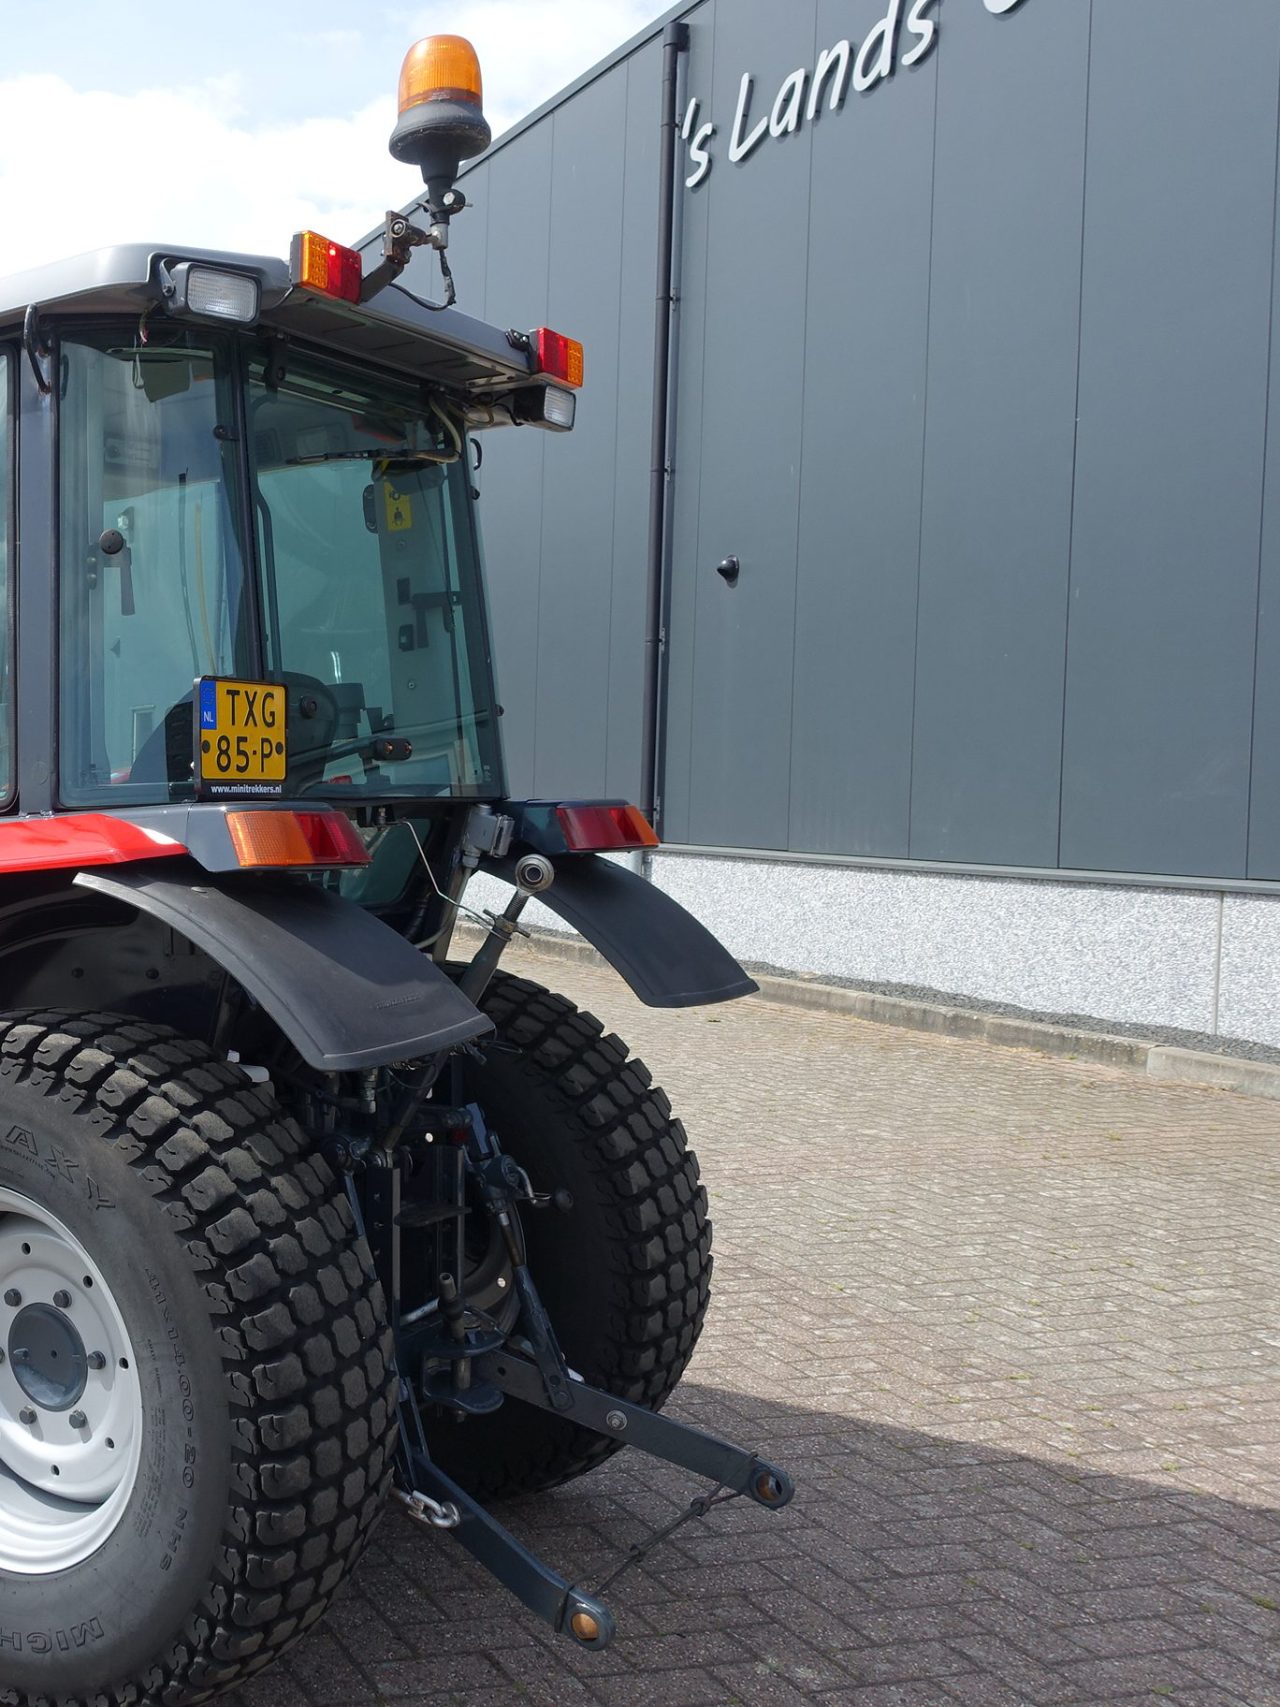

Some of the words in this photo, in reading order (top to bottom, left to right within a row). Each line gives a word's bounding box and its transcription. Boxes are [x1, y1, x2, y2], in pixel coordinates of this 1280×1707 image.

[728, 0, 934, 162] Lands
[203, 711, 214, 722] NL
[226, 689, 276, 728] TXG
[210, 784, 282, 794] www.minitrekkers.nl
[159, 1507, 188, 1572] NHS
